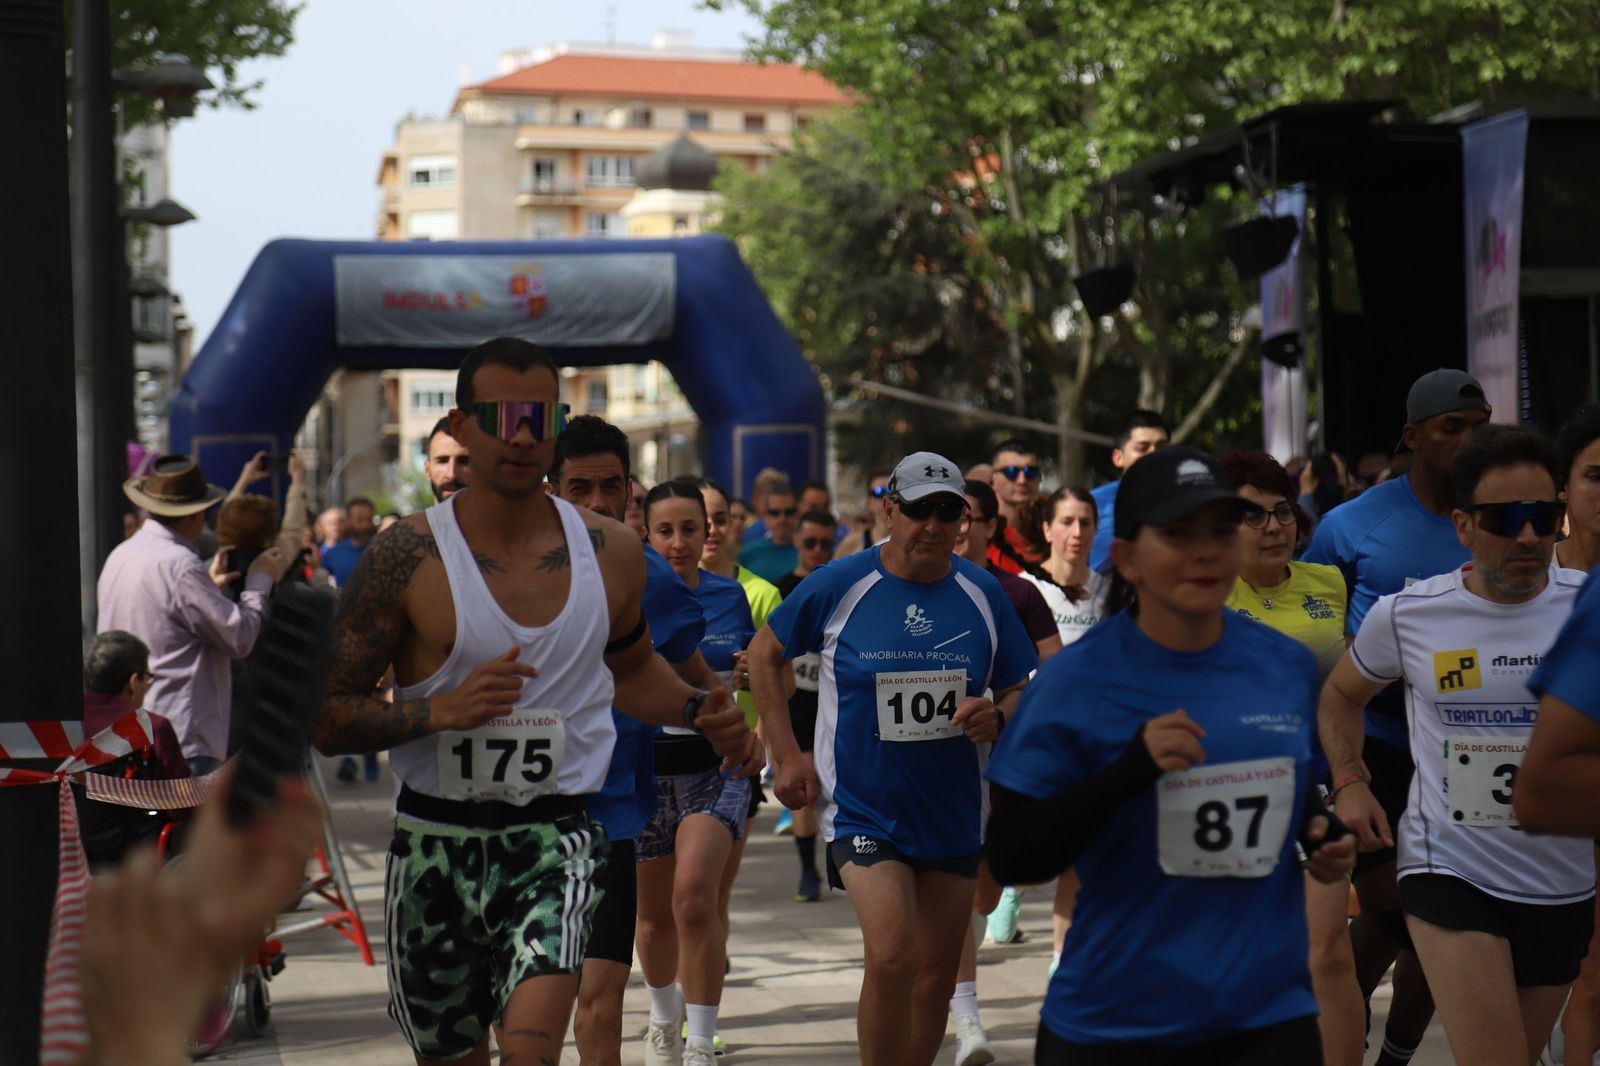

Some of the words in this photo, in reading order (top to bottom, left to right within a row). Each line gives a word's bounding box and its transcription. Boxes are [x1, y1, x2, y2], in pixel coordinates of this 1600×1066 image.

[860, 651, 923, 660] INMOBILIARIA
[926, 652, 970, 662] PROCASA
[881, 677, 893, 685] DÍA
[906, 676, 938, 684] CASTILLA
[945, 674, 962, 683] LEÓN
[887, 690, 957, 724] 104
[533, 716, 557, 726] LEÓN
[1445, 709, 1512, 723] TRIATLON
[1454, 743, 1469, 751] DÍA
[1472, 744, 1483, 752] DE
[1487, 745, 1528, 753] CASTILLA
[452, 738, 553, 783] 175
[1166, 780, 1185, 790] DÍA
[1188, 778, 1202, 788] DE
[1206, 773, 1252, 786] CASTILLA
[1254, 771, 1263, 780] Y
[1194, 795, 1269, 851] 87
